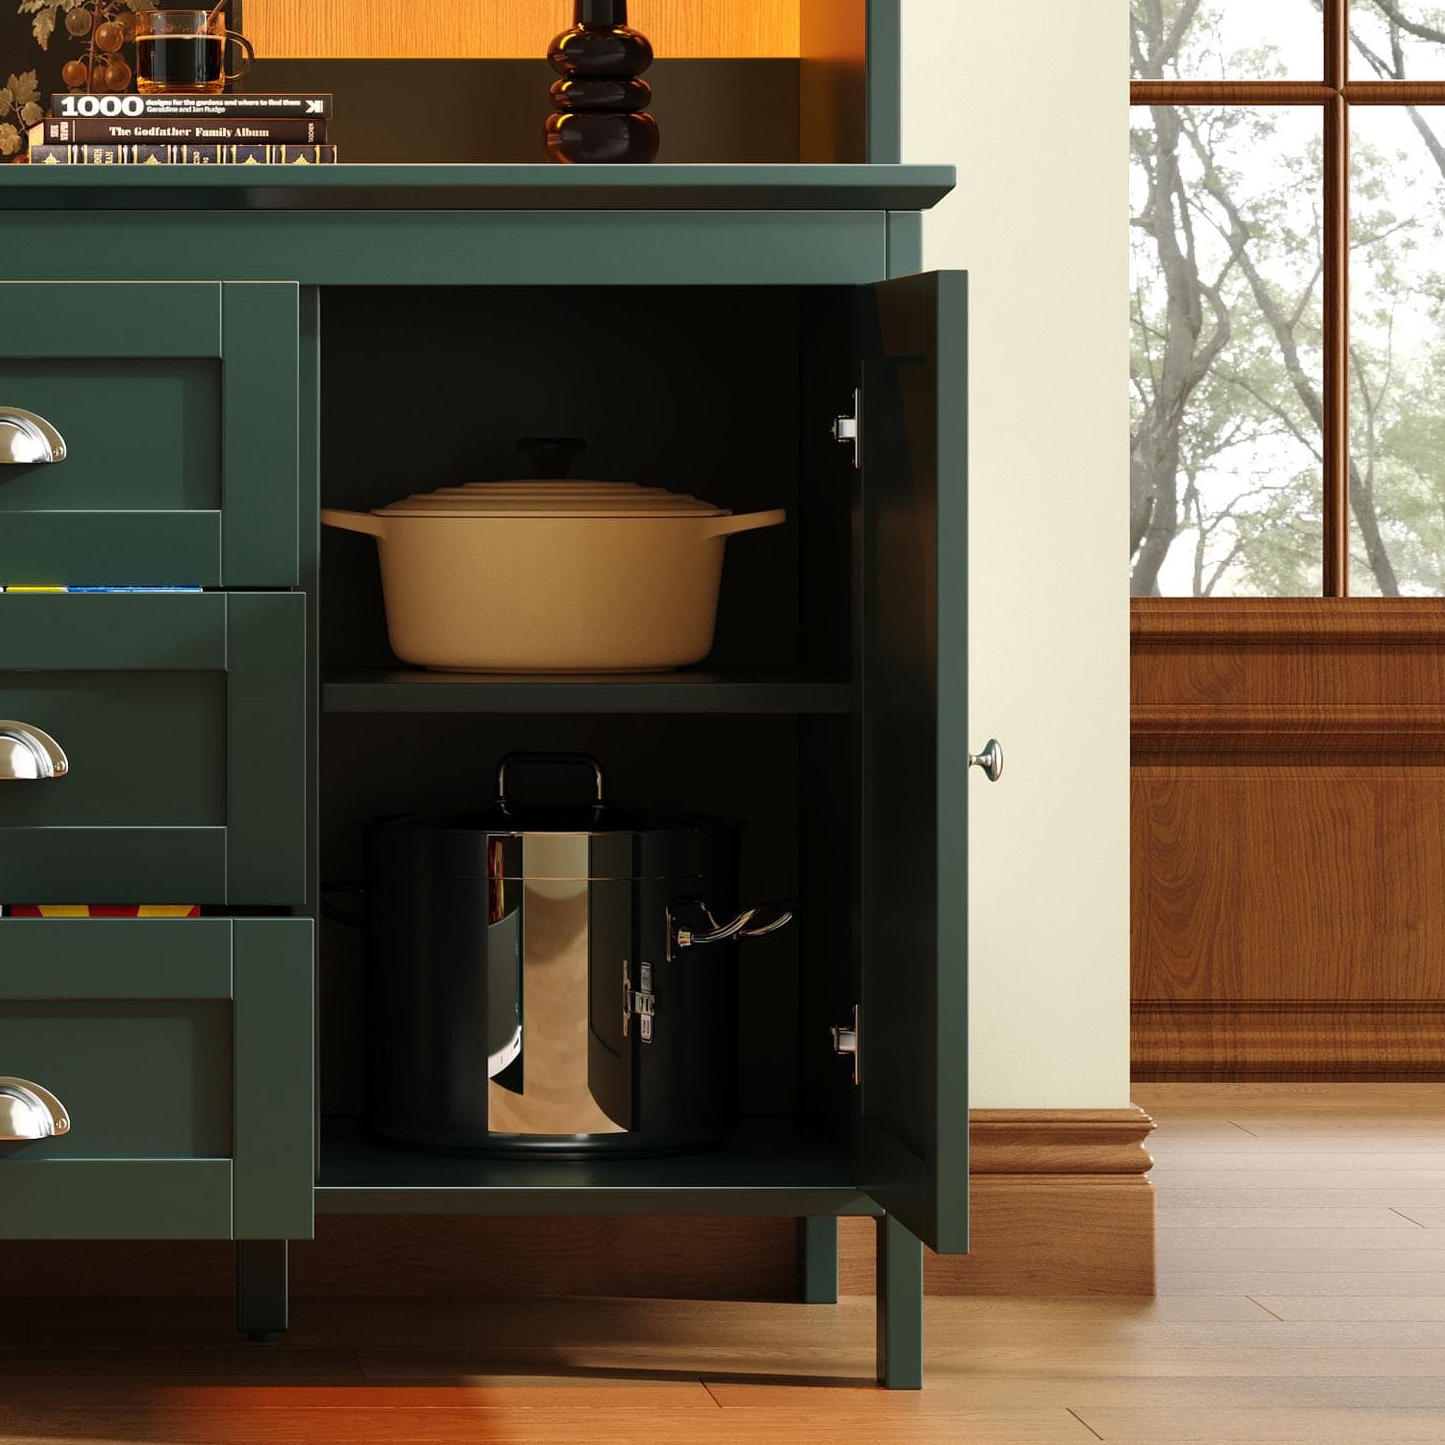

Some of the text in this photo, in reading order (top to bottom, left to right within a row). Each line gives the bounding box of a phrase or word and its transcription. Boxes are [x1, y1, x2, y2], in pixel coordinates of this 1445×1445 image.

[61, 95, 144, 117] 1000
[109, 126, 270, 138] The Godfather Family Album
